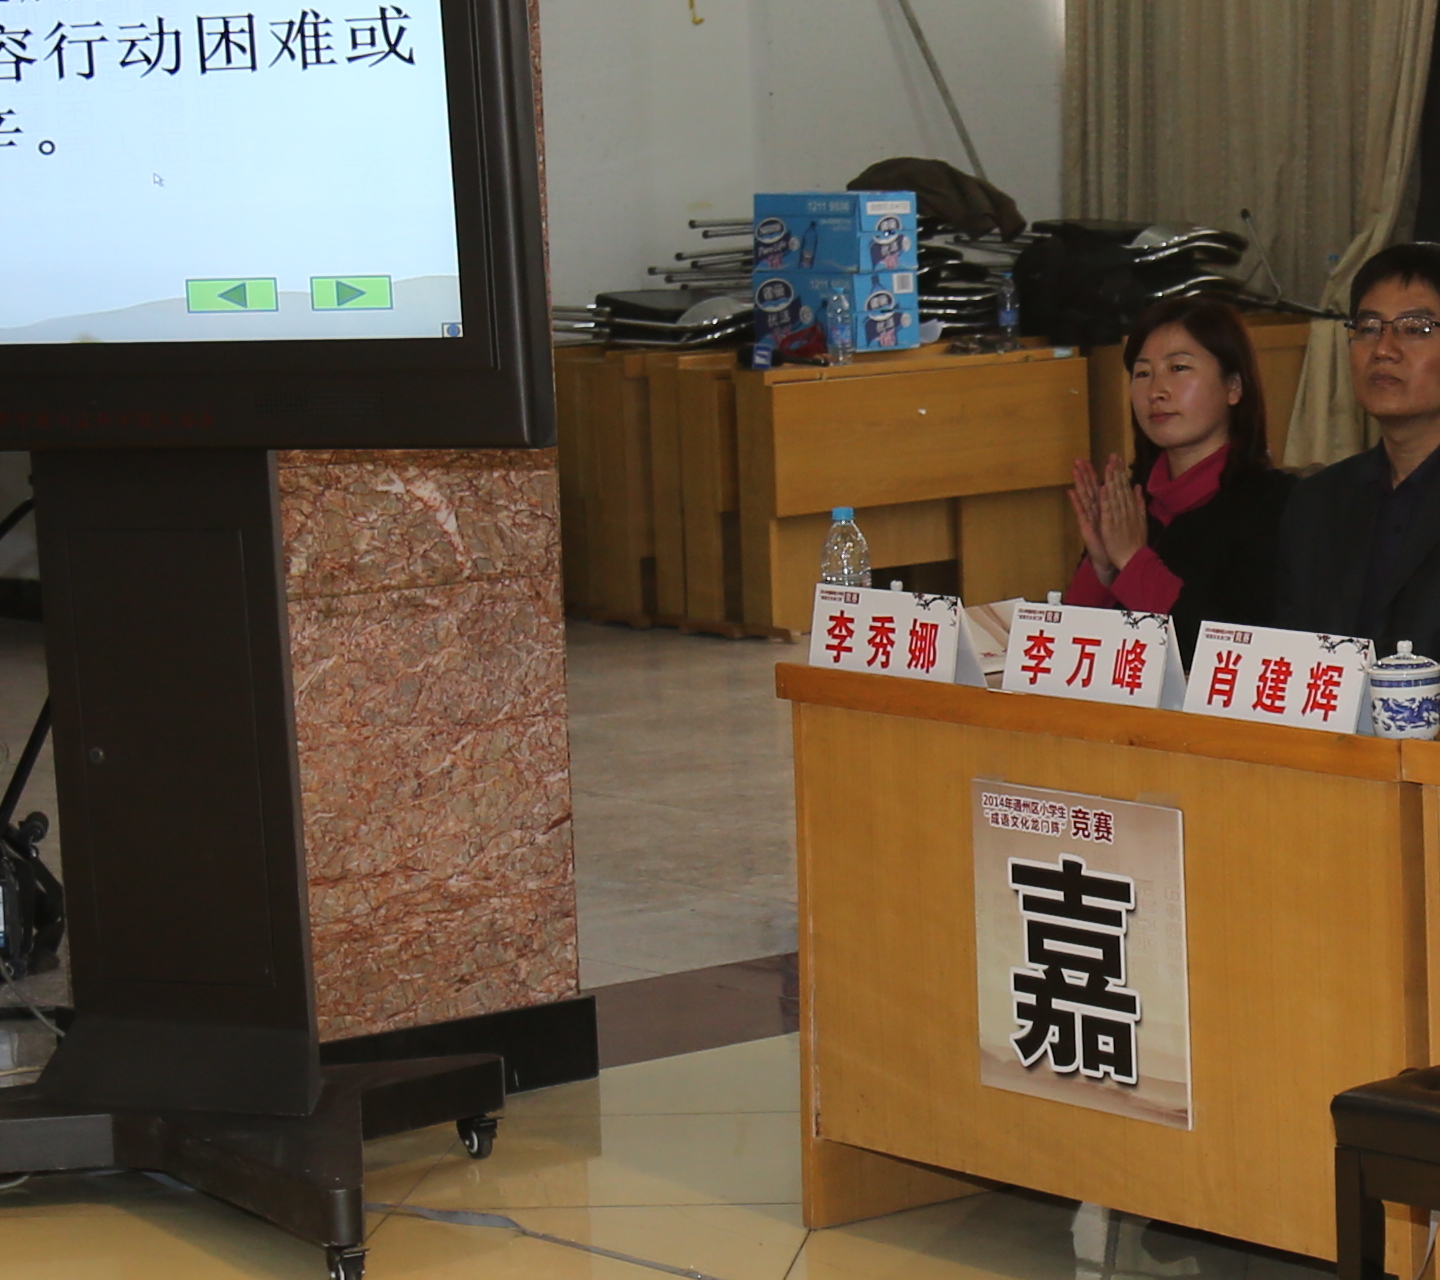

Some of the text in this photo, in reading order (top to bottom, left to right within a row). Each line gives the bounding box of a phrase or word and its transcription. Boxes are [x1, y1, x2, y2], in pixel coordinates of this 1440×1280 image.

[824, 610, 940, 673] 李秀娜
[1021, 630, 1149, 696] 李万峰
[1207, 650, 1345, 722] 肖建辉
[1071, 808, 1113, 842] 竞赛
[1009, 857, 1140, 1085] 嘉
